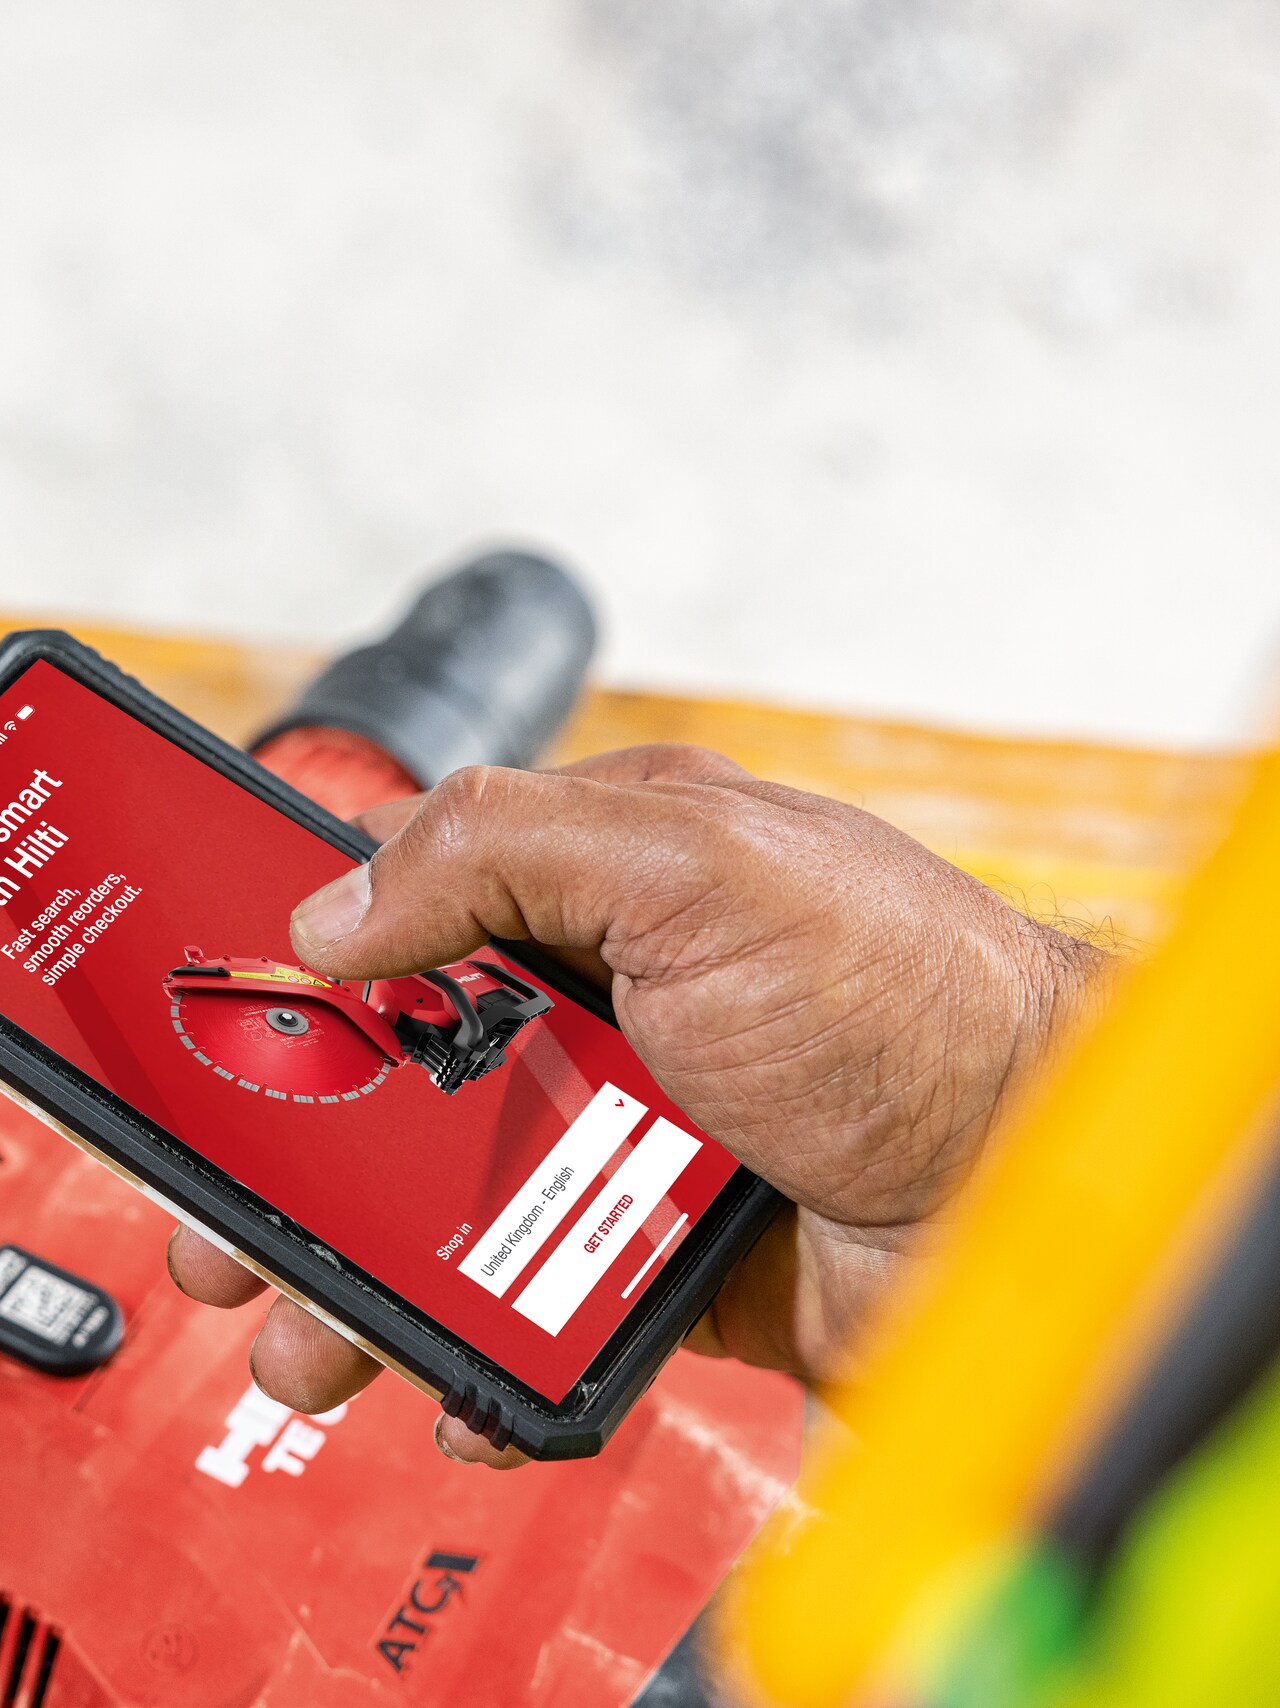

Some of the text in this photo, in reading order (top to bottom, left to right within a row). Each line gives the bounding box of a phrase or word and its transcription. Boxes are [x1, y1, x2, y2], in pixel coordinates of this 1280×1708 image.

[3, 820, 70, 879] Hilti
[0, 887, 82, 960] Fast search,
[22, 872, 127, 973] smooth reorders,
[41, 884, 143, 986] simple checkout.
[435, 1222, 473, 1261] Shop in
[480, 1242, 513, 1277] United
[504, 1205, 545, 1247] Kingdom
[541, 1165, 575, 1201] English
[583, 1193, 634, 1255] GET STARTED
